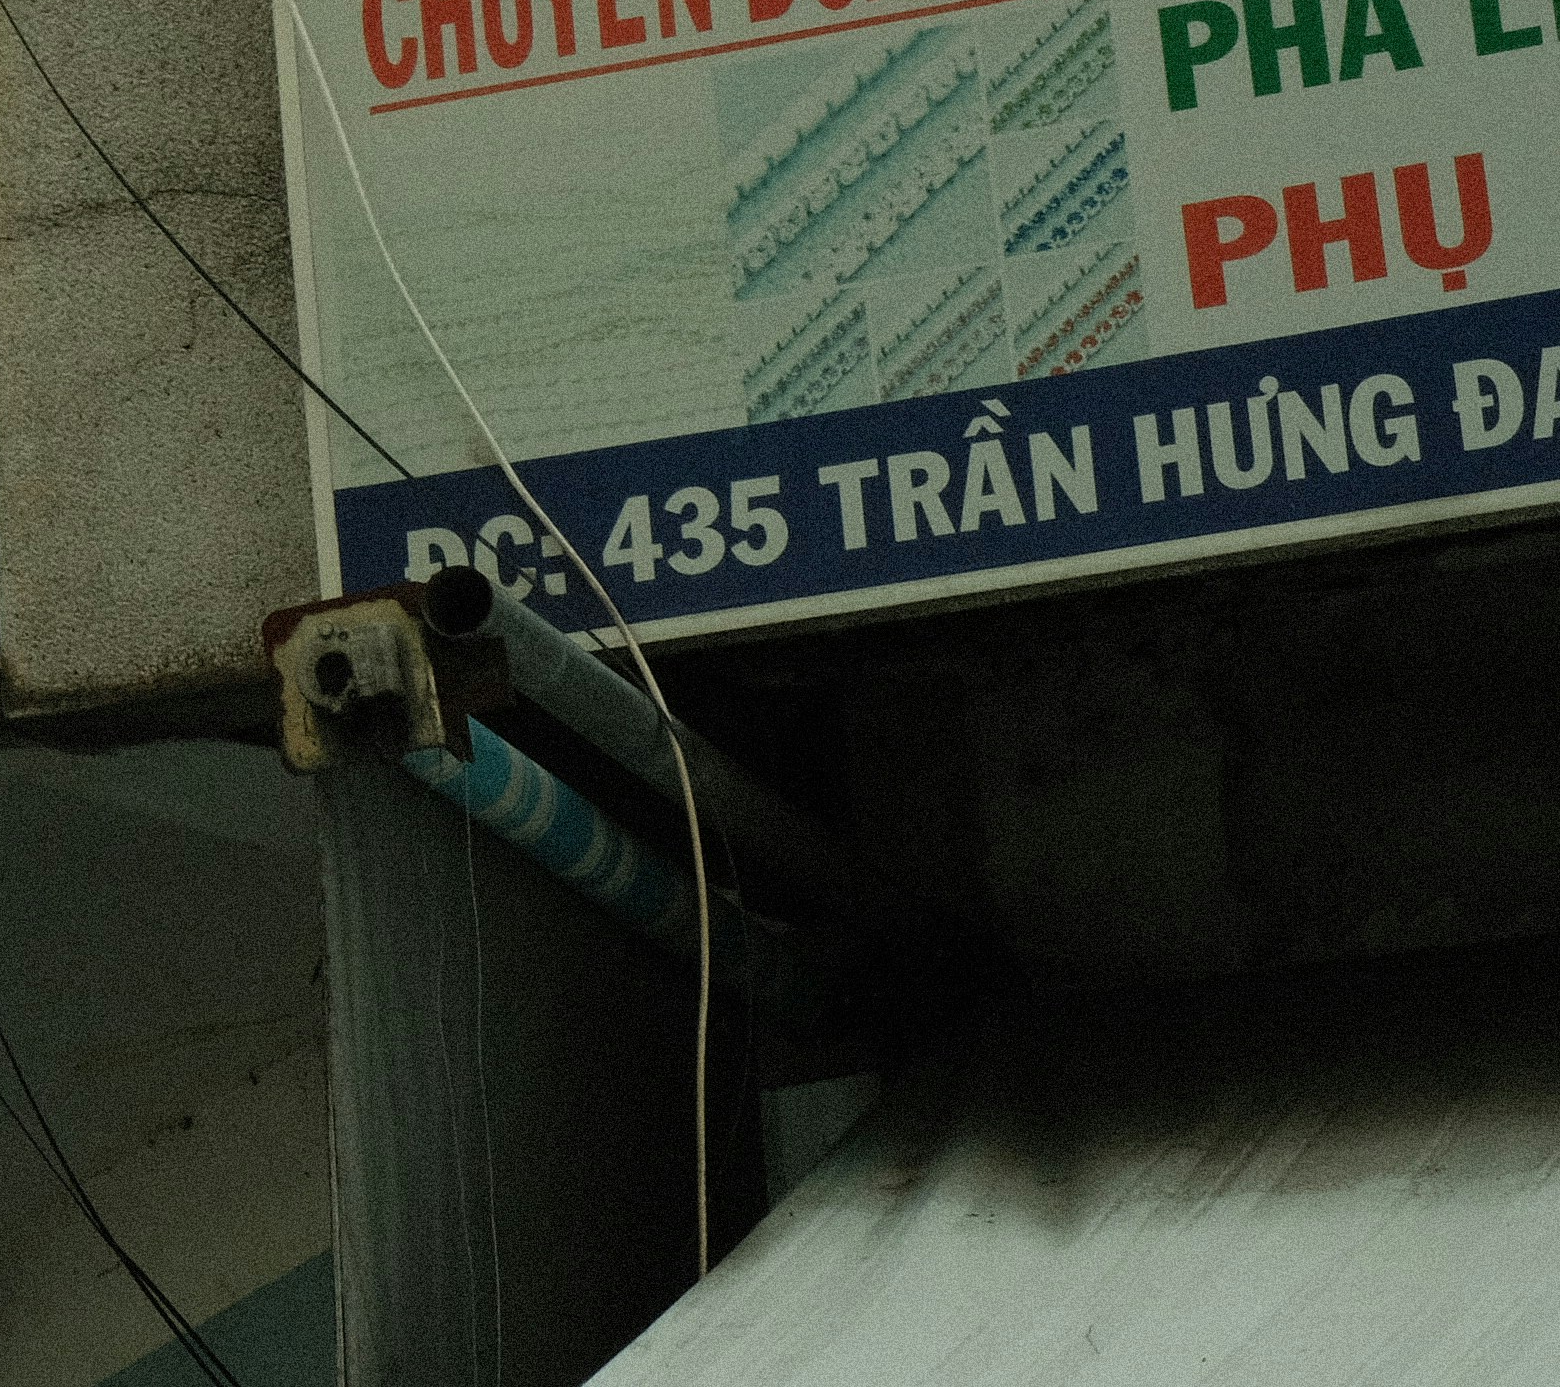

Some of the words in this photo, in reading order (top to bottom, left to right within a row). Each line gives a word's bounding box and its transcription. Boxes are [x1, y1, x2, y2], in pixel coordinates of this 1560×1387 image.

[1181, 152, 1493, 310] PHỤ
[602, 474, 790, 583] 435
[818, 399, 1100, 551] TRẦN
[1132, 373, 1422, 505] HƯNG
